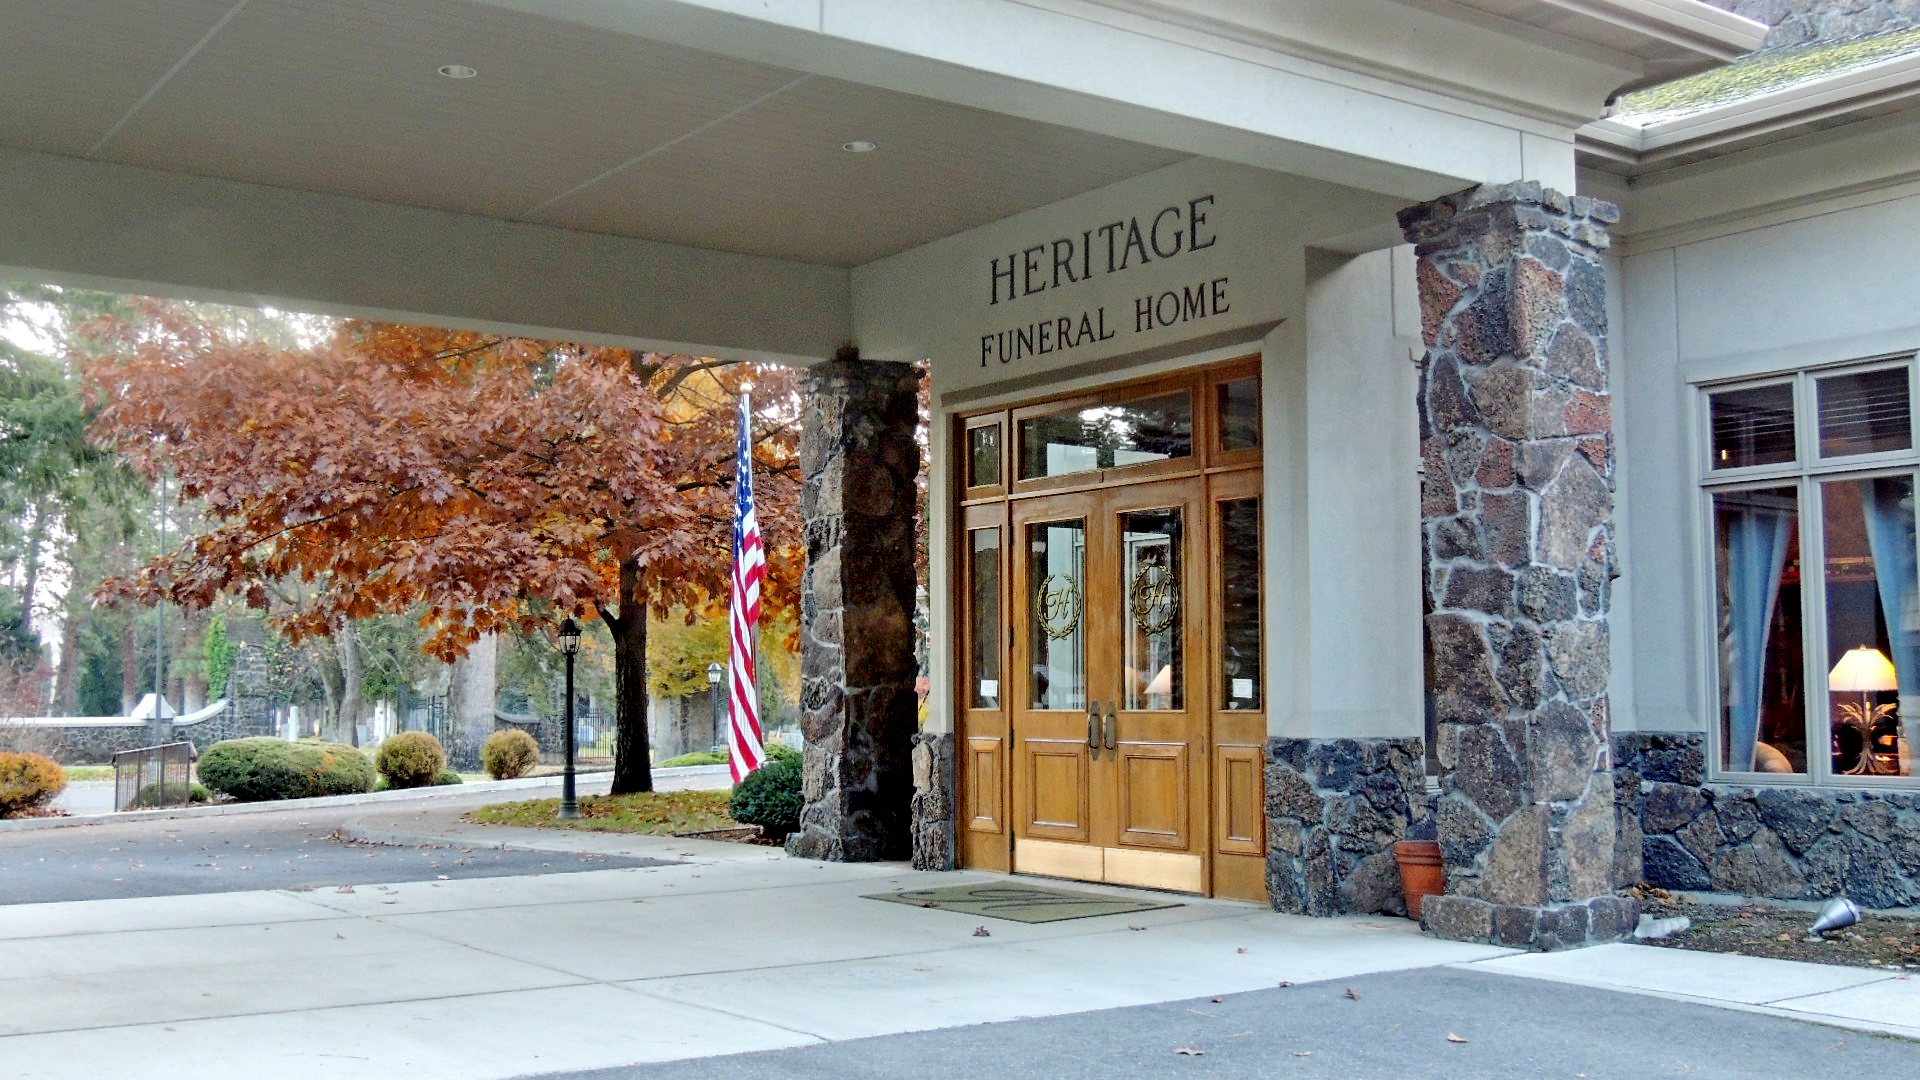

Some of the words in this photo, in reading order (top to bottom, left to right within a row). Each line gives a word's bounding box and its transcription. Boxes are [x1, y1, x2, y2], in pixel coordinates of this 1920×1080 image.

[990, 194, 1216, 304] HERITAGE
[980, 306, 1116, 367] FUNERAL
[1135, 277, 1231, 333] HOME
